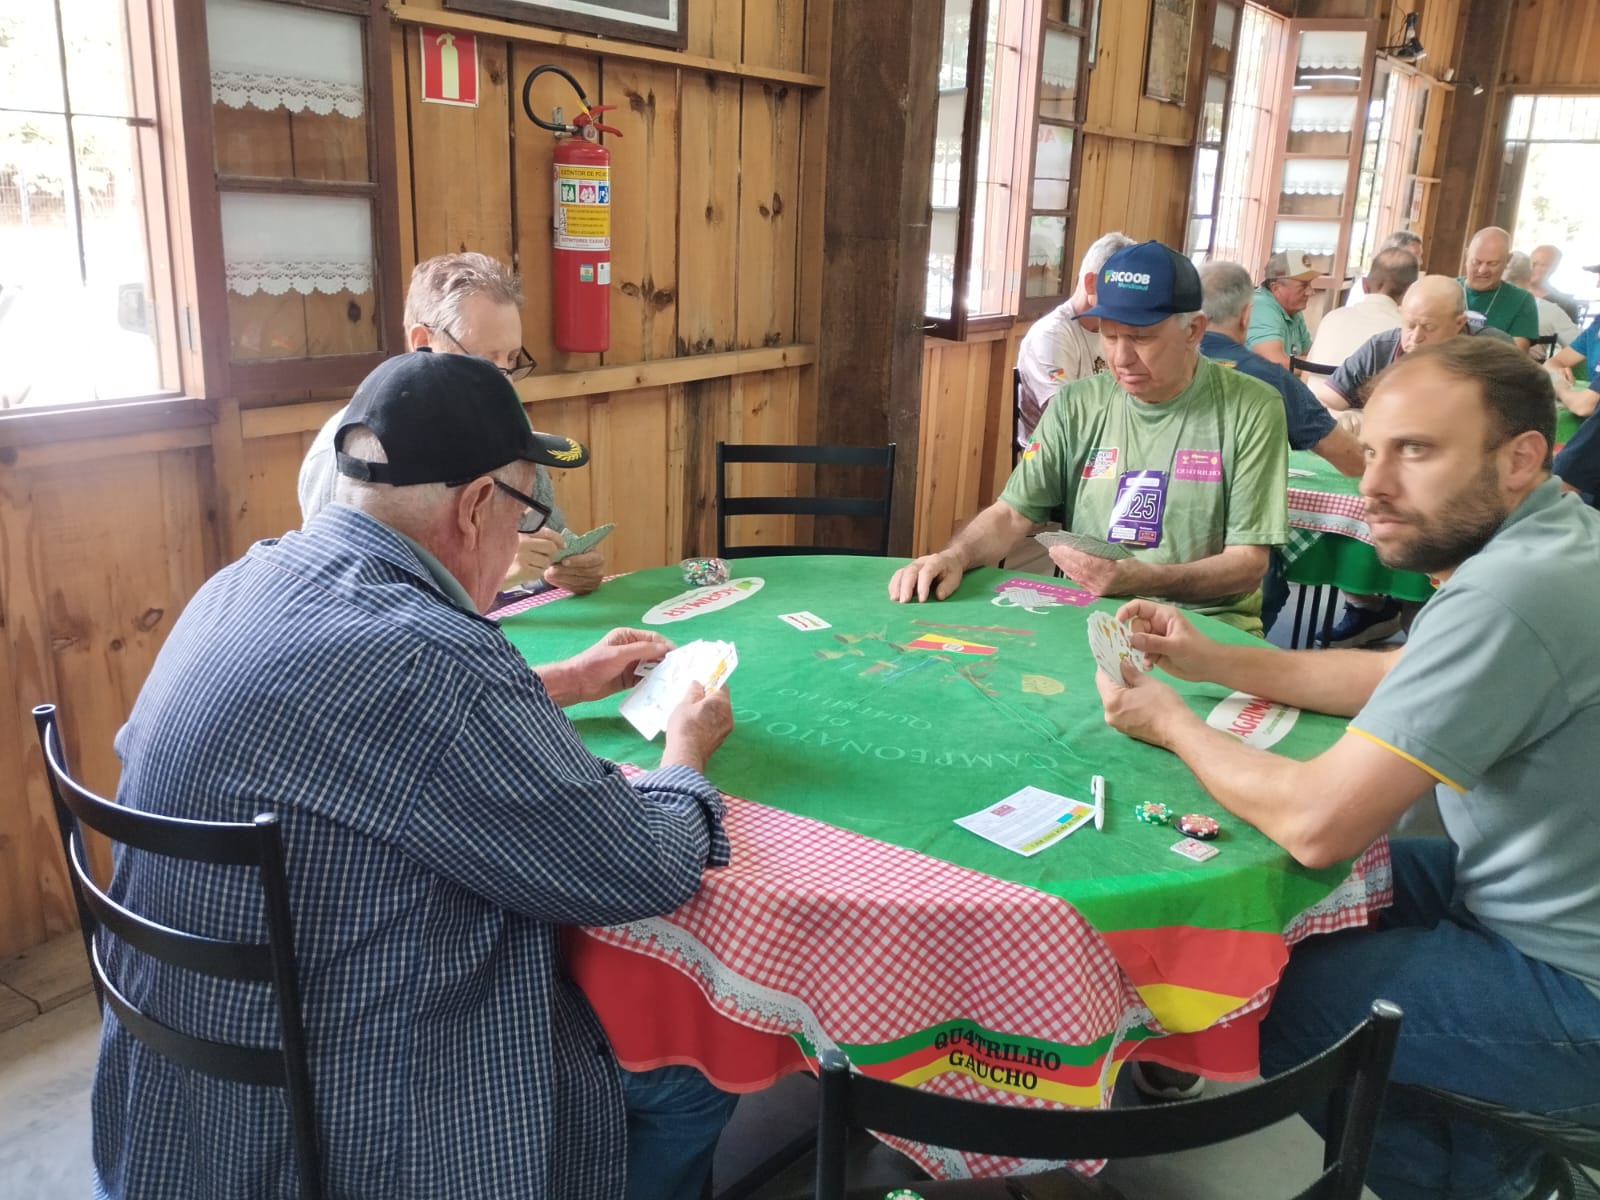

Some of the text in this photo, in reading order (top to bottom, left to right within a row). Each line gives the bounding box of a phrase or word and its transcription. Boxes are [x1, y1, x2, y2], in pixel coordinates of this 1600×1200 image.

[1110, 271, 1151, 285] SICOOB
[1227, 696, 1274, 739] AGRIMA
[766, 721, 1059, 769] CAMPEONATO
[935, 1027, 1061, 1071] QU4TRILHO
[949, 1050, 1038, 1090] GAUCHO
